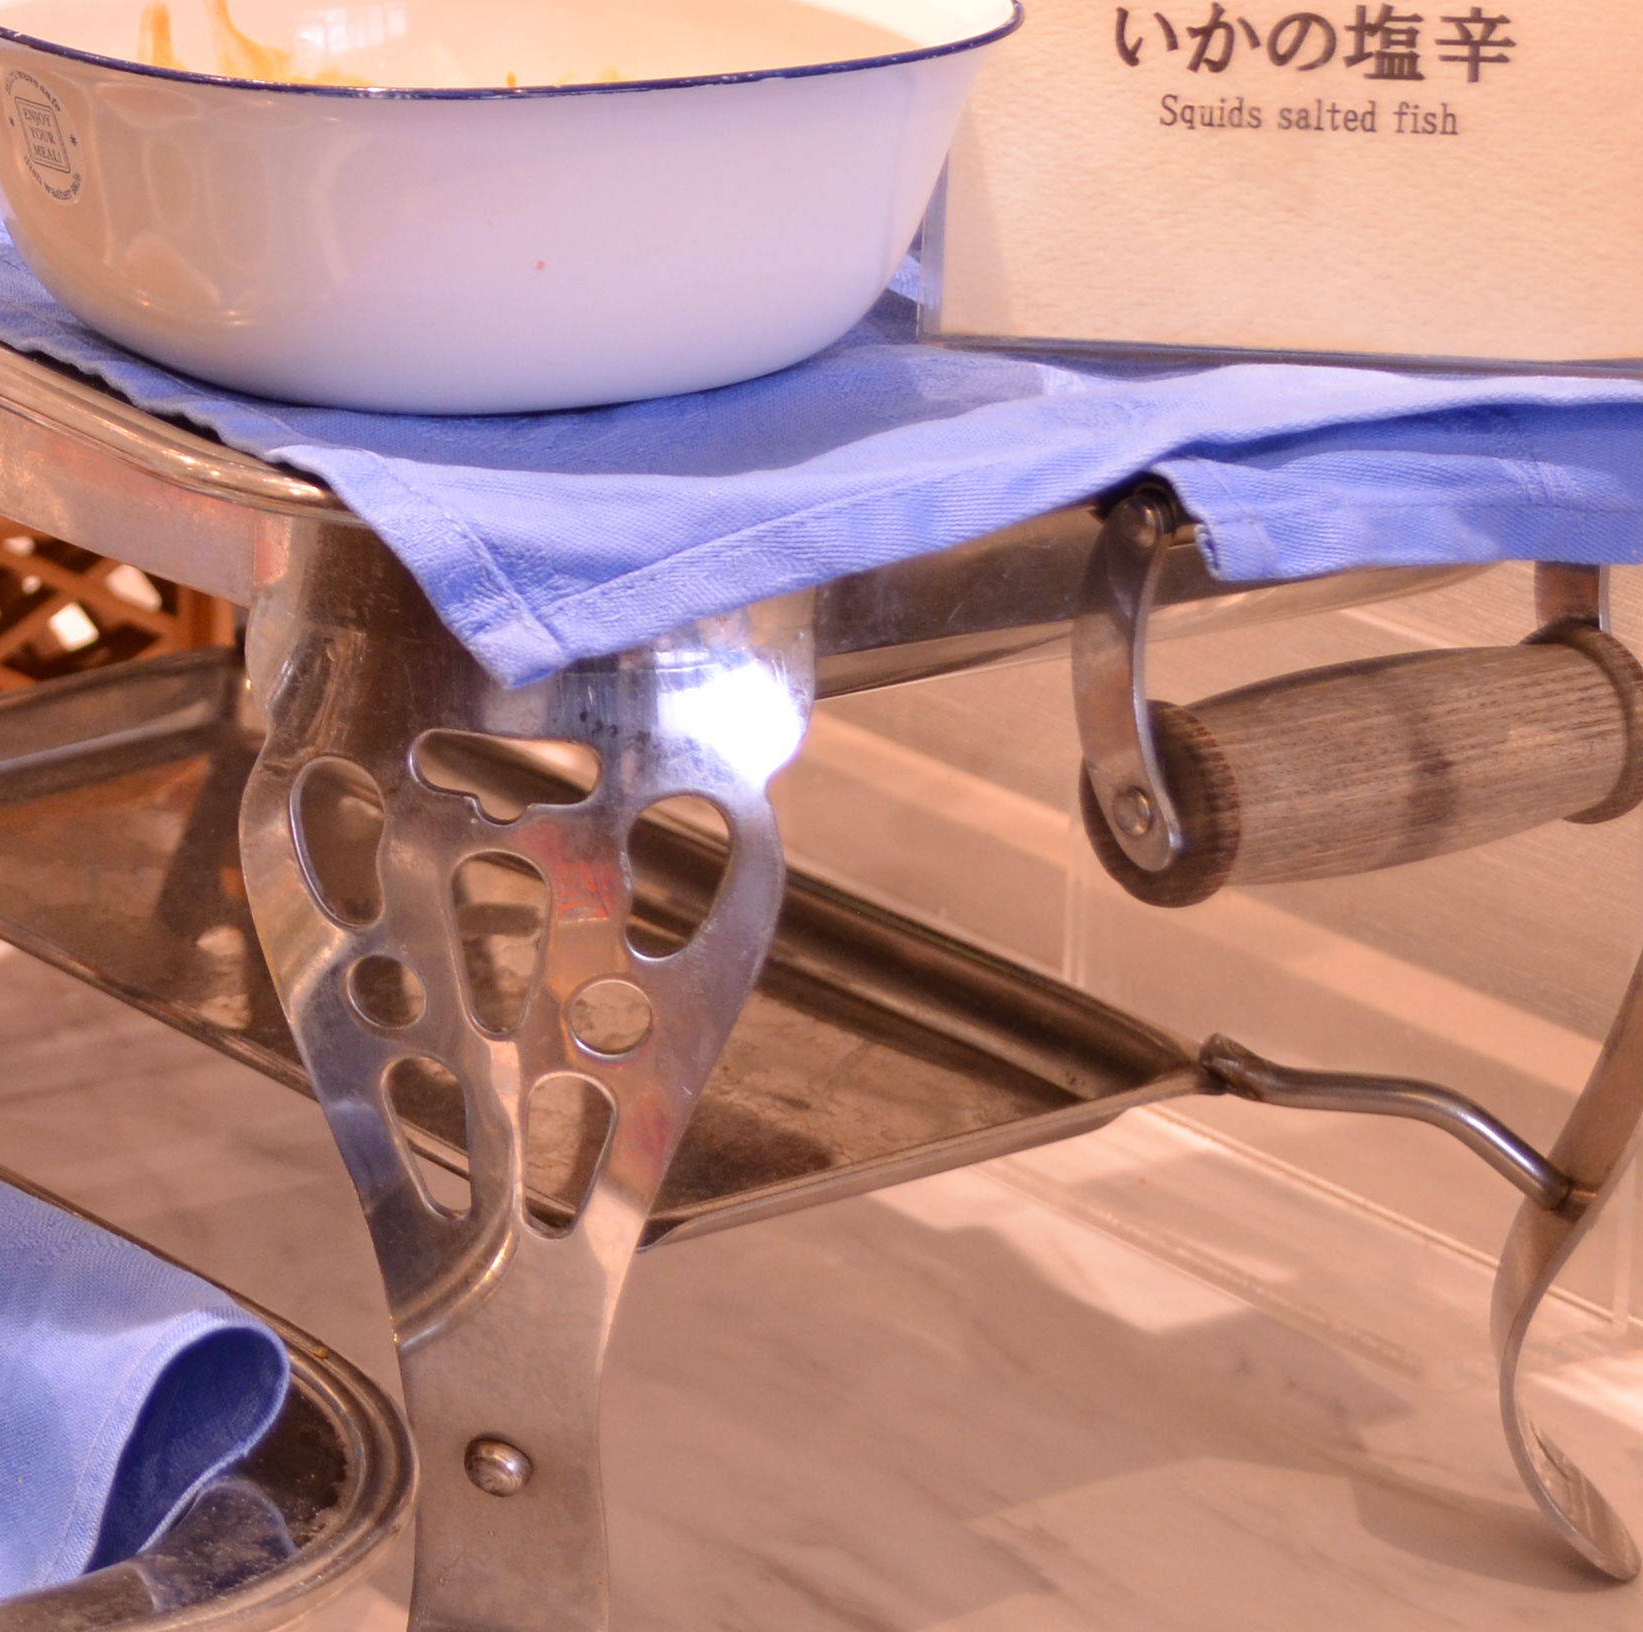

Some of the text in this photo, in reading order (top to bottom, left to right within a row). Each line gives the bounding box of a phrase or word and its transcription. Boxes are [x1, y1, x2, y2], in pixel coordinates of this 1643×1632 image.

[1114, 1, 1516, 84] いかの塩辛
[23, 107, 52, 128] ENJOY
[1159, 93, 1460, 137] Squids salted fish
[29, 127, 56, 145] YOUR
